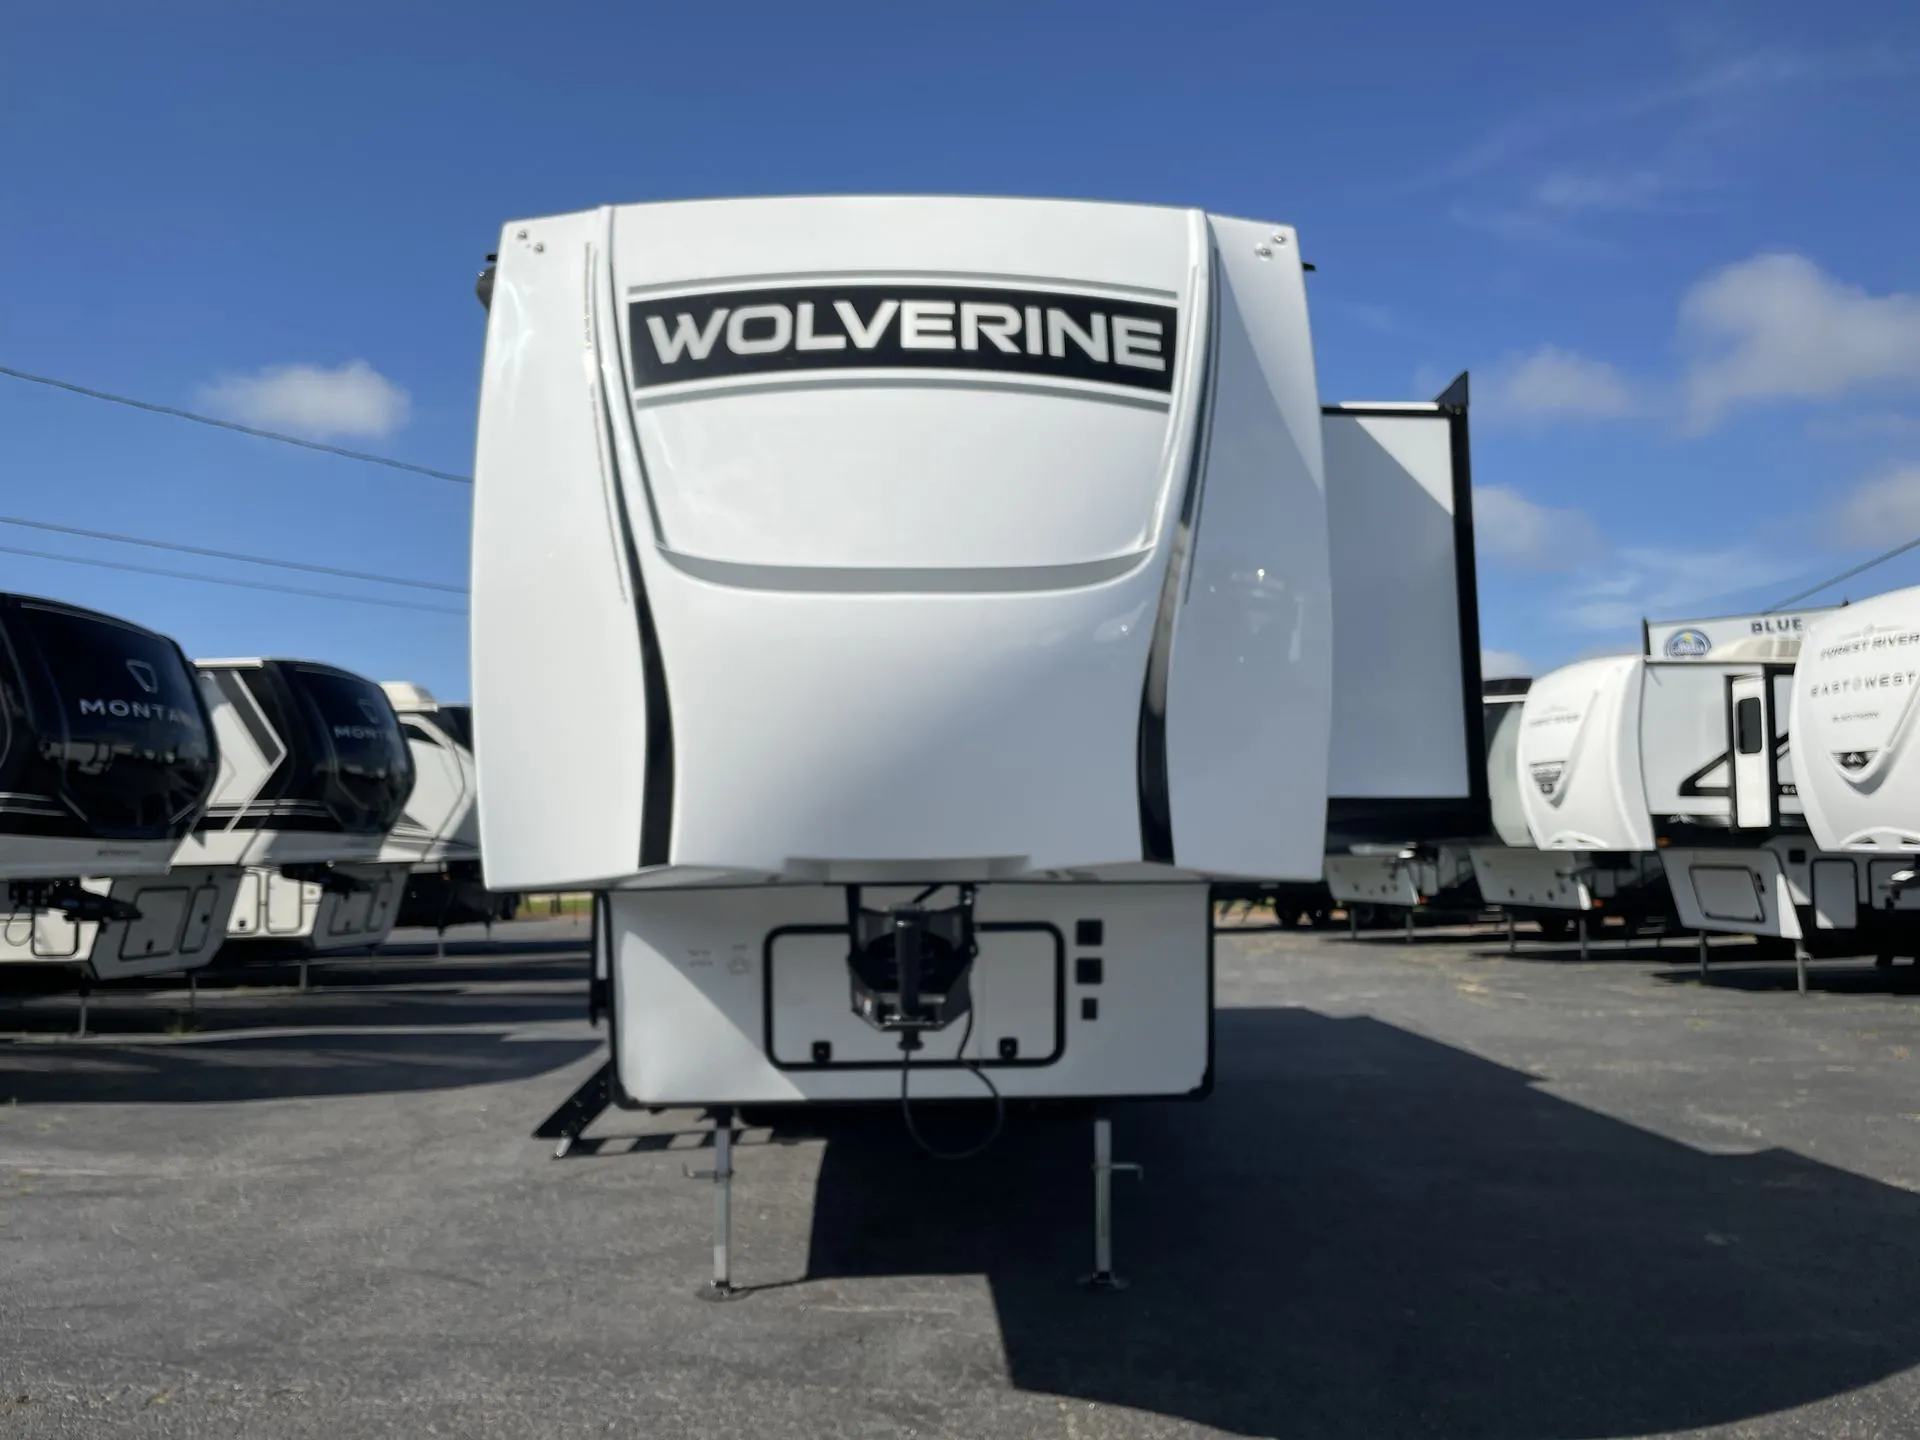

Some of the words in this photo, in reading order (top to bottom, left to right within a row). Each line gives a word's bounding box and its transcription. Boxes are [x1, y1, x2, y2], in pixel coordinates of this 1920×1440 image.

[646, 299, 1167, 372] WOLVERINE
[1751, 618, 1802, 634] BLUE
[1871, 631, 1920, 650] RIVER
[79, 698, 192, 722] MONTA
